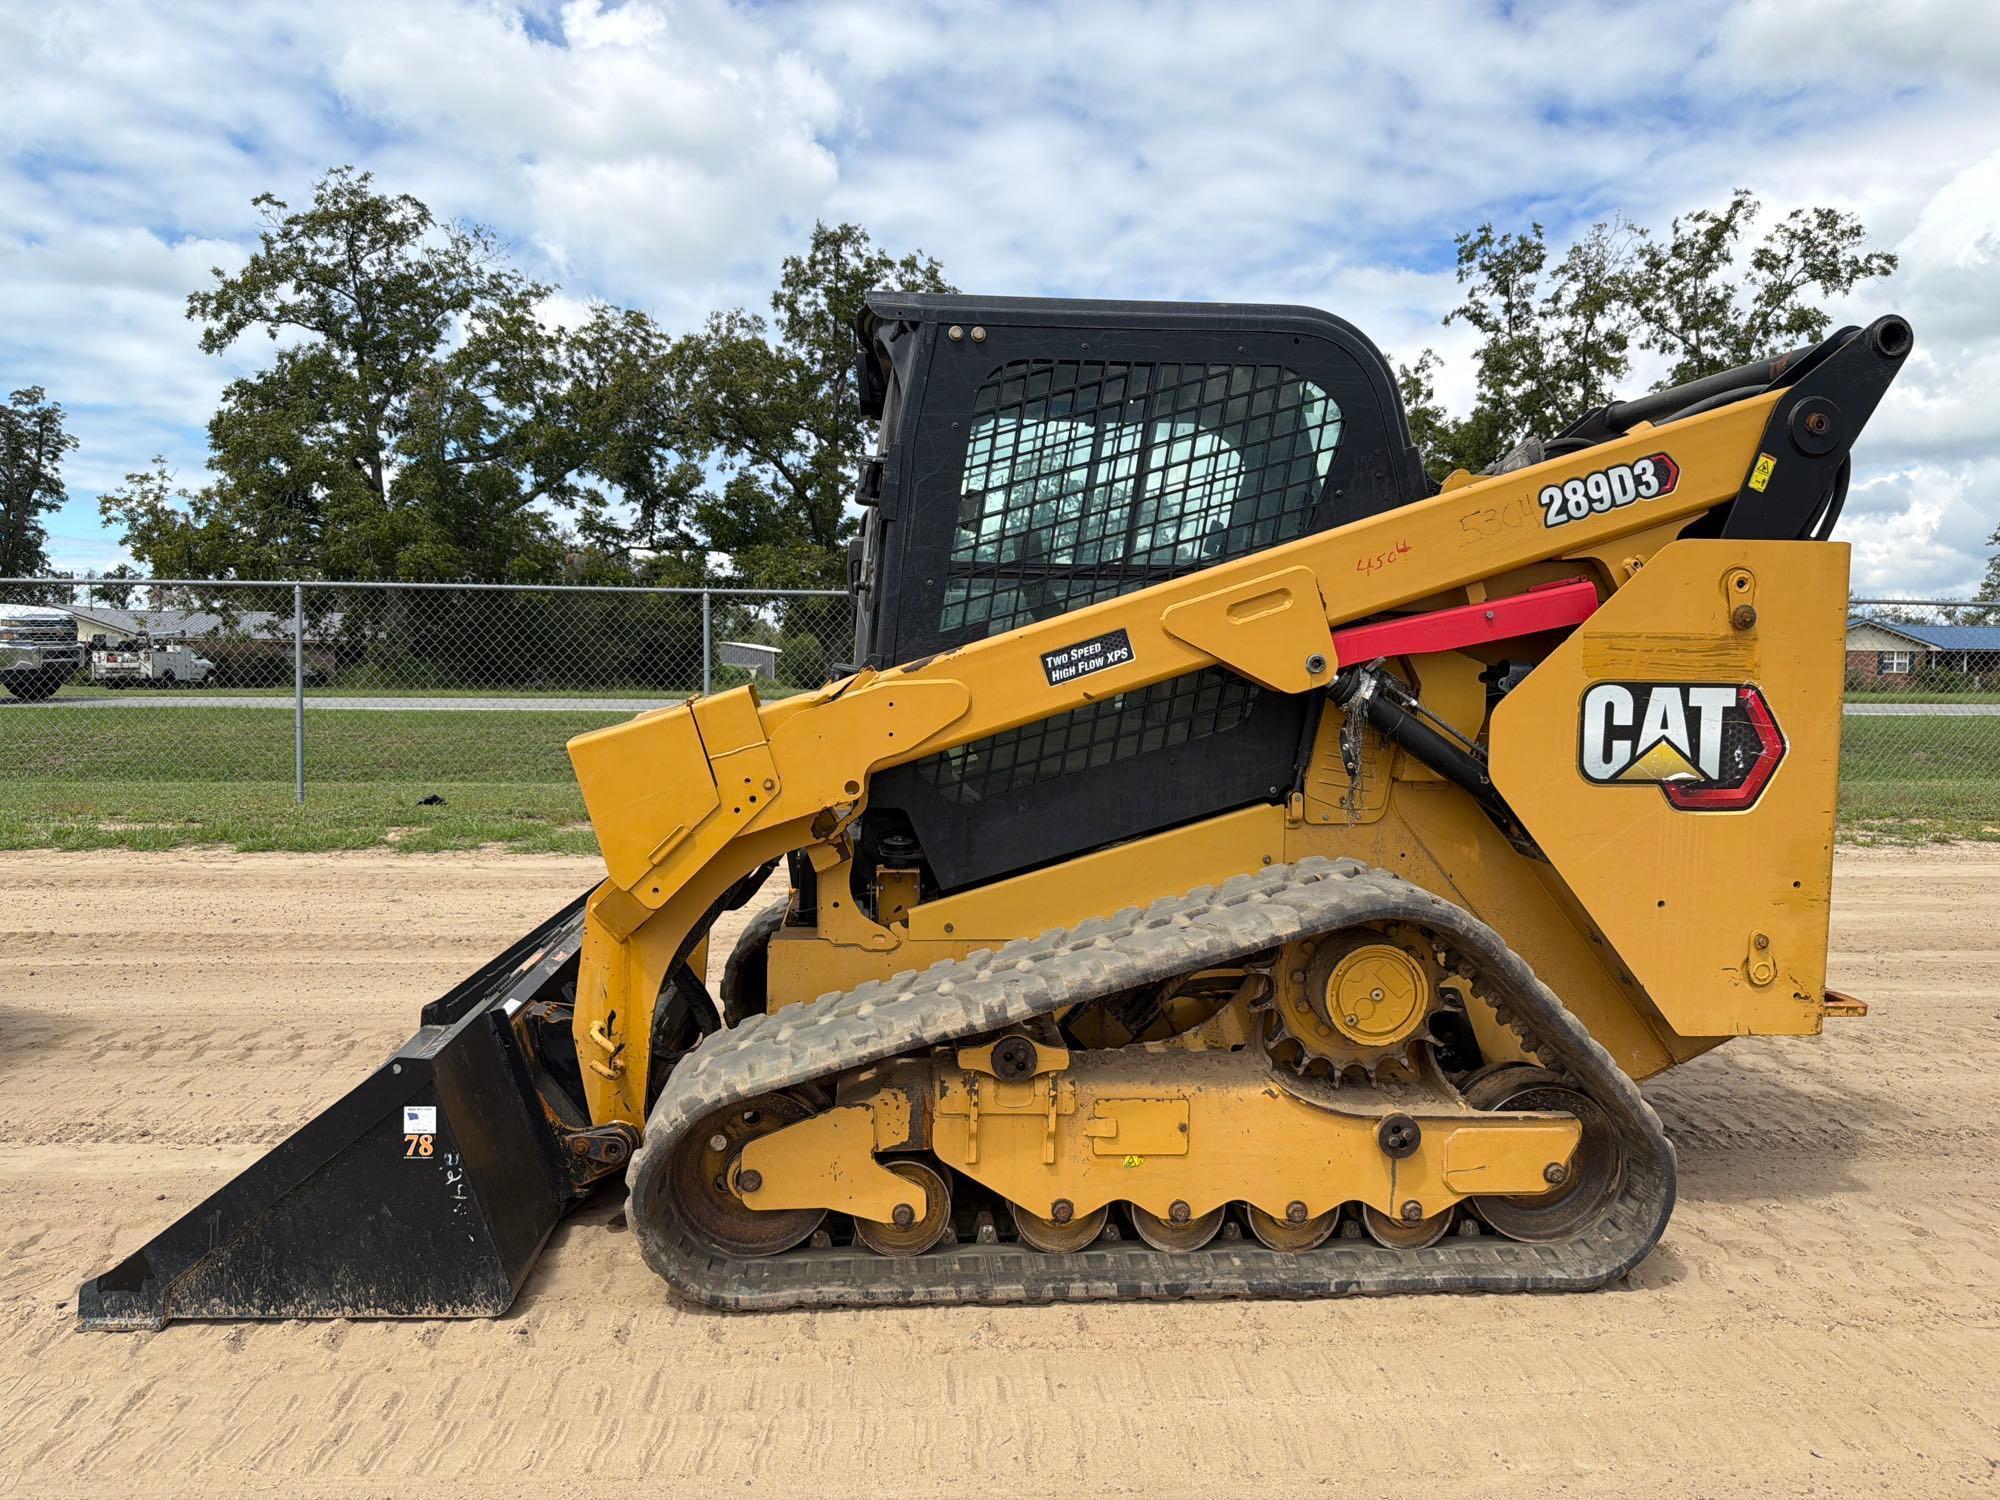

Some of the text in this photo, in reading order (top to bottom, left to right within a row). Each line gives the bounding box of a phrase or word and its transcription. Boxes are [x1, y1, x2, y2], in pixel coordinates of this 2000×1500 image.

[1541, 459, 1659, 526] 289D3
[1107, 648, 1128, 664] XPS
[1584, 685, 1737, 780] CAT
